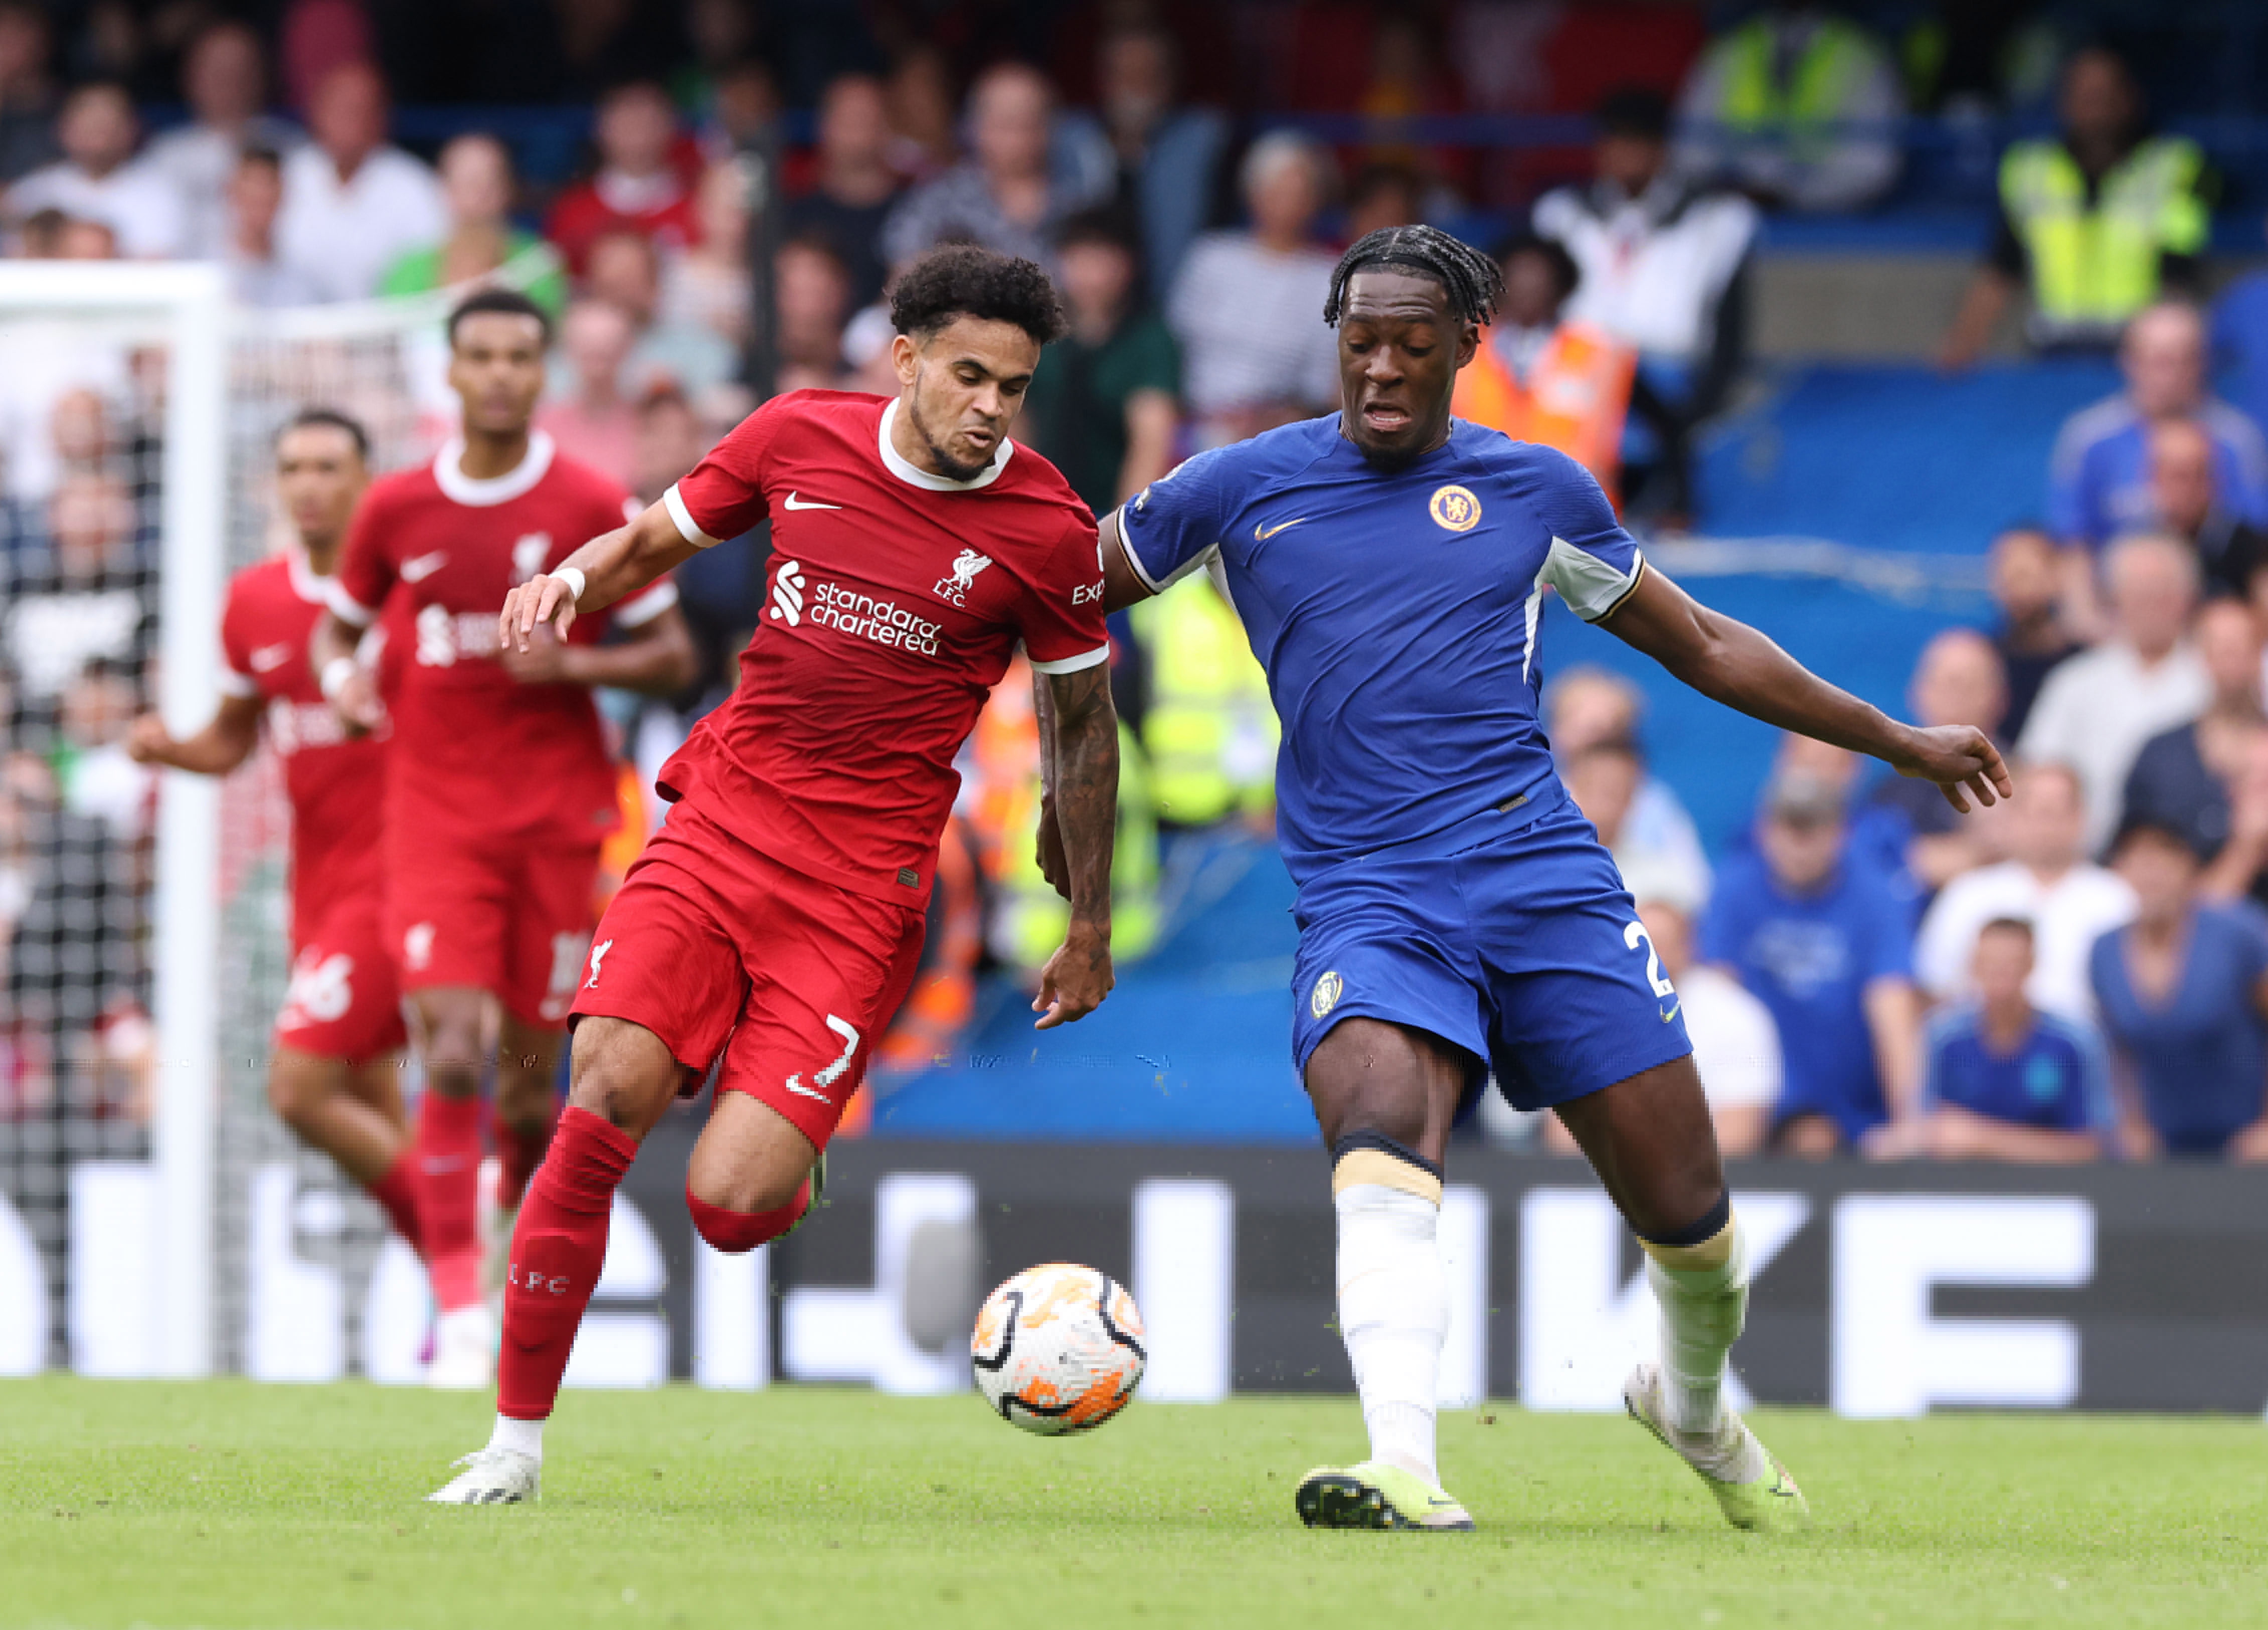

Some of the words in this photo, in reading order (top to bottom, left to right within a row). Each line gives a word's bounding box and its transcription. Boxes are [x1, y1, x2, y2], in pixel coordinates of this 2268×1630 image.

[810, 604, 941, 656] chartered
[814, 582, 943, 639] standard
[1623, 921, 1676, 998] 2
[813, 1013, 860, 1087] 7
